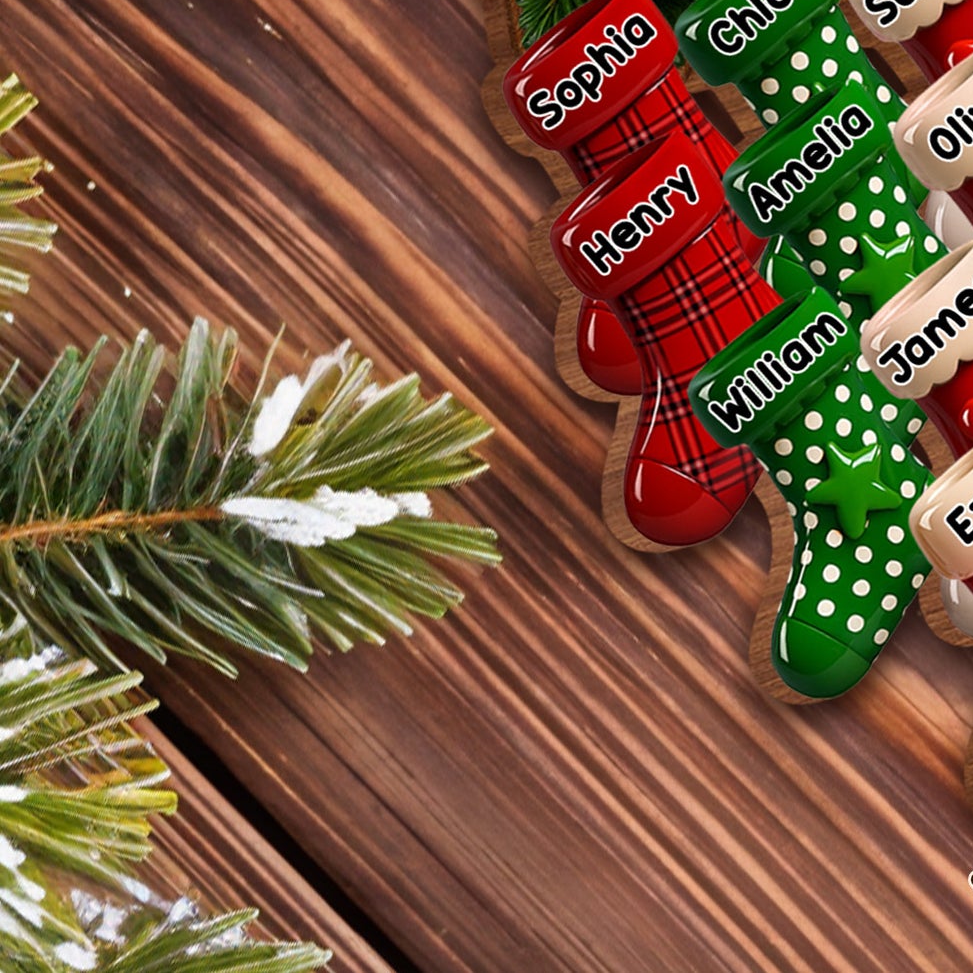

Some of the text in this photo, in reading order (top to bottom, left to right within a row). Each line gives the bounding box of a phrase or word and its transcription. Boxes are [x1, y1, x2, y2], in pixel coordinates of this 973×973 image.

[527, 12, 657, 130] Sophia
[580, 165, 699, 276] Henry
[748, 104, 873, 222] Amelia
[708, 311, 848, 433] William
